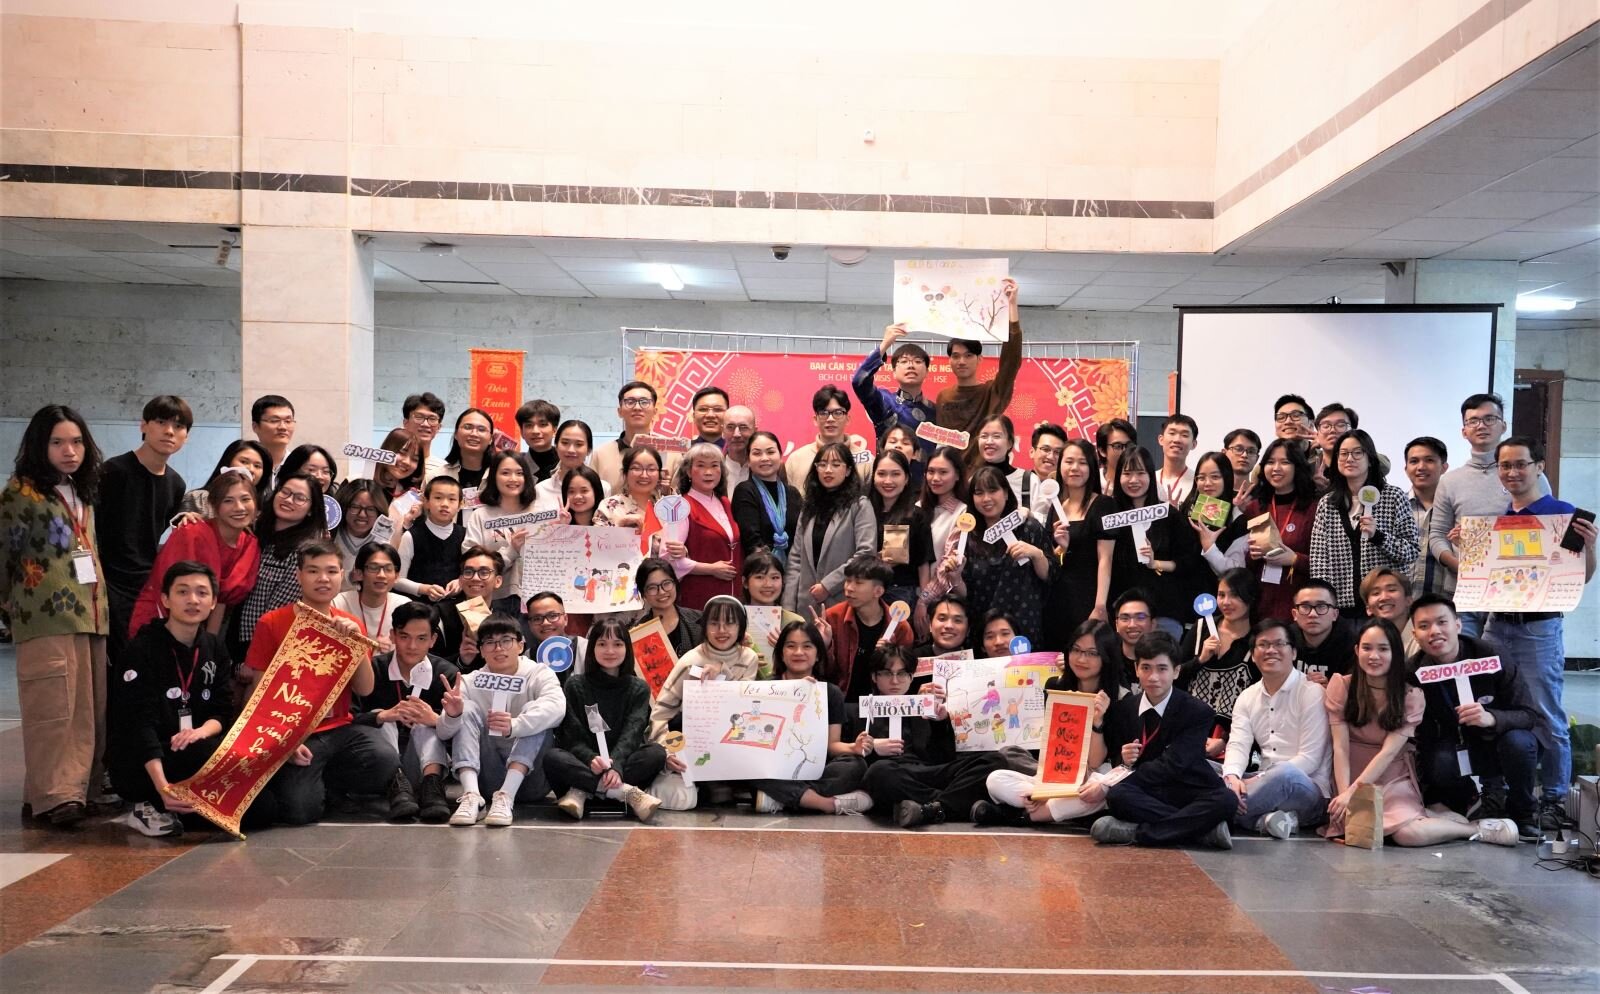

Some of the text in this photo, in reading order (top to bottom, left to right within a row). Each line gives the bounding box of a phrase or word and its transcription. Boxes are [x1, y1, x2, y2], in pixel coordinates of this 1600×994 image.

[344, 444, 396, 464] #MISIS
[986, 511, 1021, 542] #HSE
[1104, 506, 1167, 528] #MGIMO
[1420, 659, 1499, 681] 28/01/2023
[474, 674, 524, 692] #HSE
